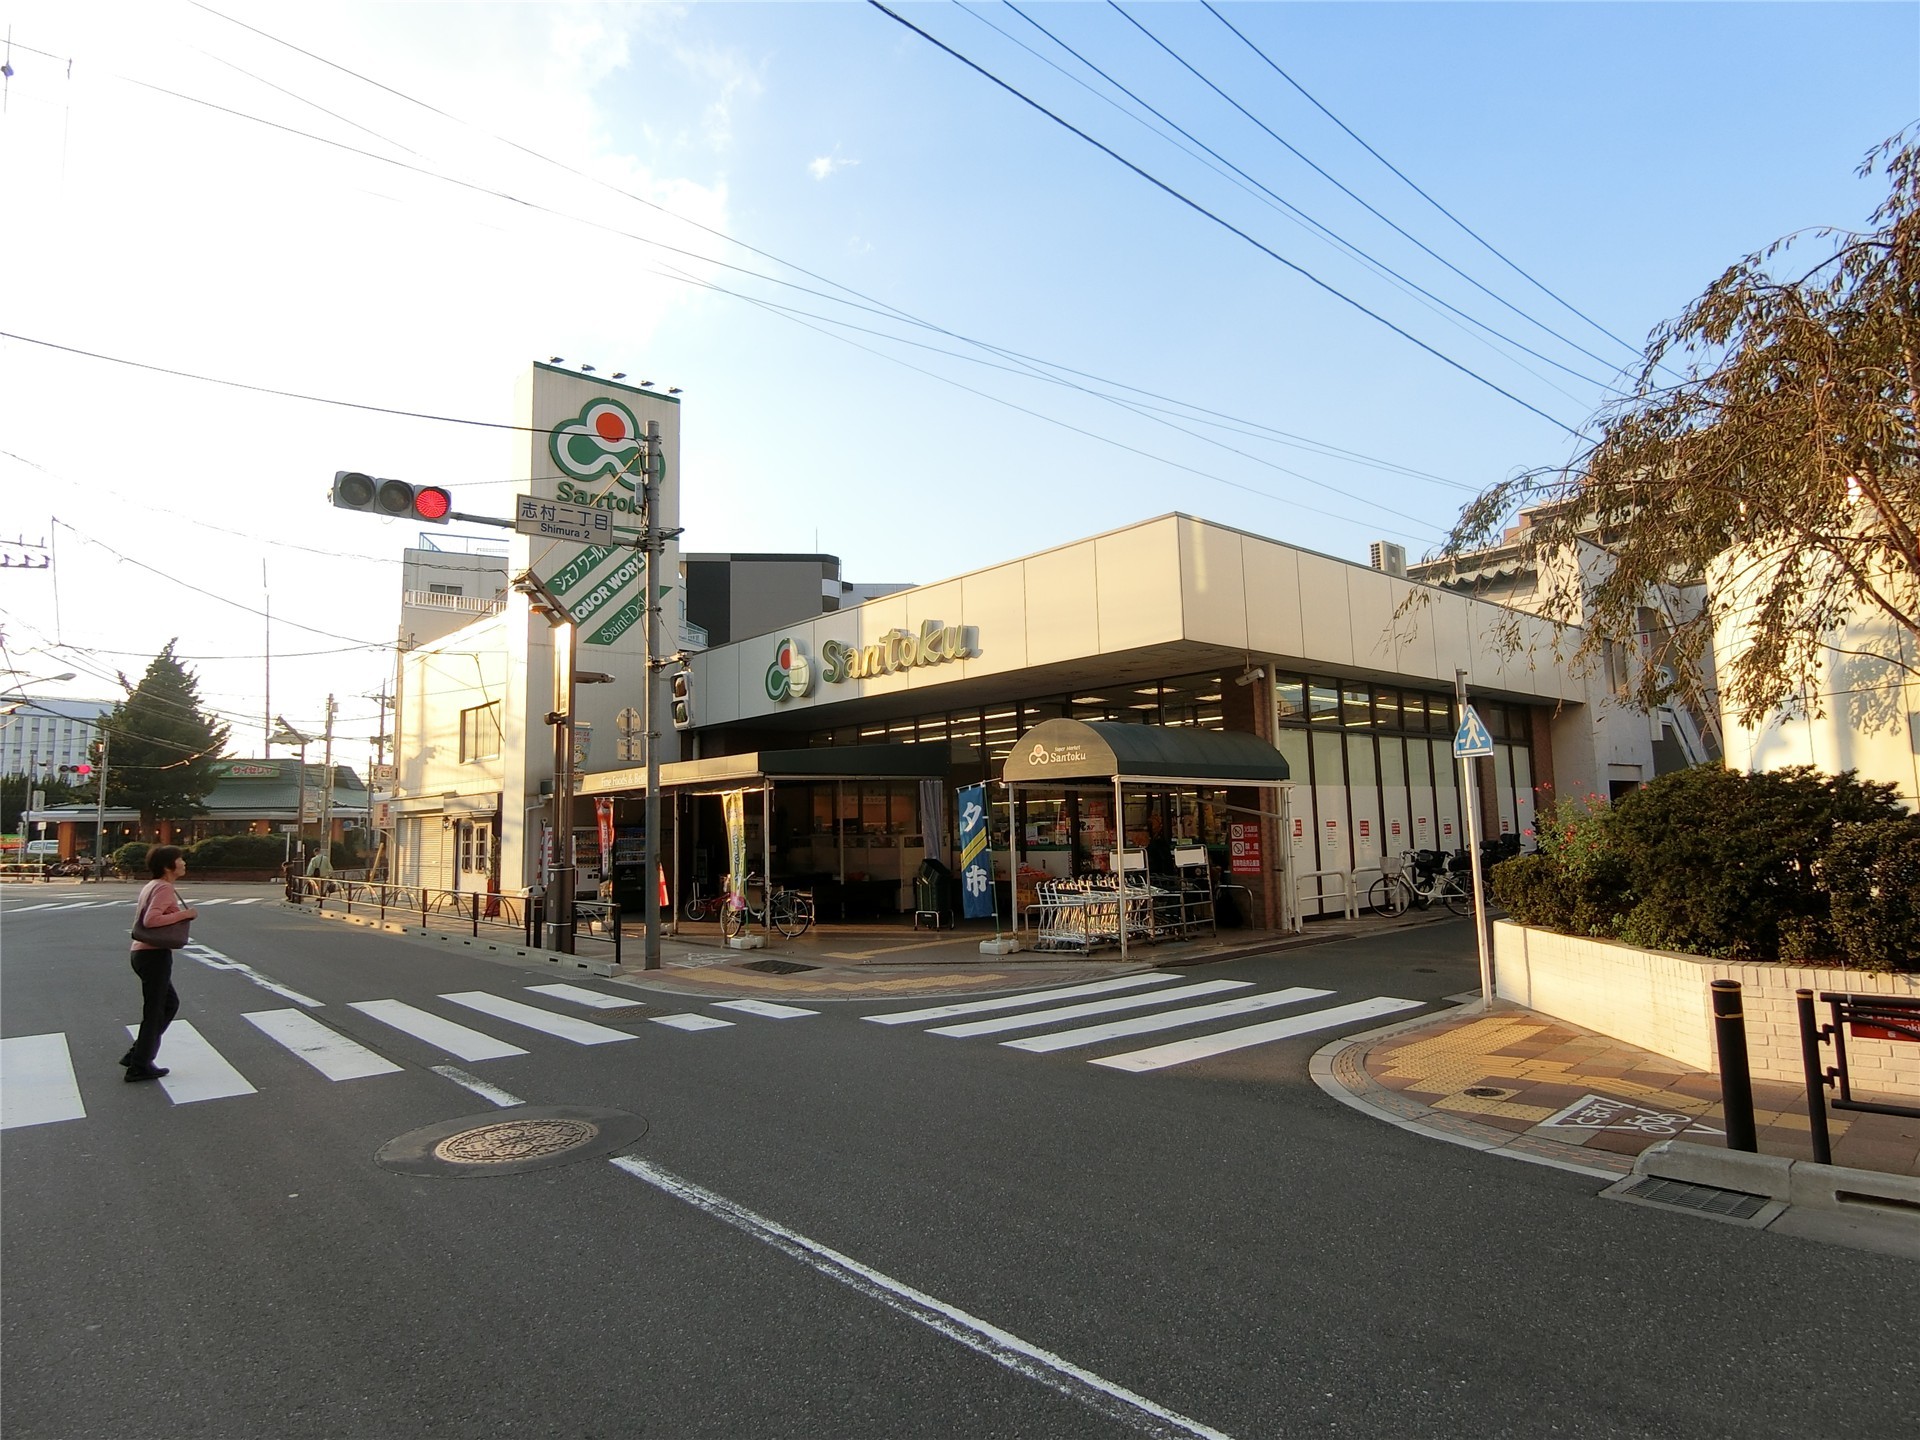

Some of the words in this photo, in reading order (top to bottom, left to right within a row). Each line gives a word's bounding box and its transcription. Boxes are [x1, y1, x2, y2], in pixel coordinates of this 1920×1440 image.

[557, 481, 642, 515] Santok
[522, 502, 608, 530] 志村二丁目
[541, 522, 580, 537] Shimura
[584, 530, 591, 539] 2
[554, 546, 608, 591] シェフワール
[570, 585, 611, 623] IQUOR
[822, 619, 983, 683] Santoku
[1050, 751, 1087, 763] Santoku
[1566, 1102, 1624, 1125] とまれ
